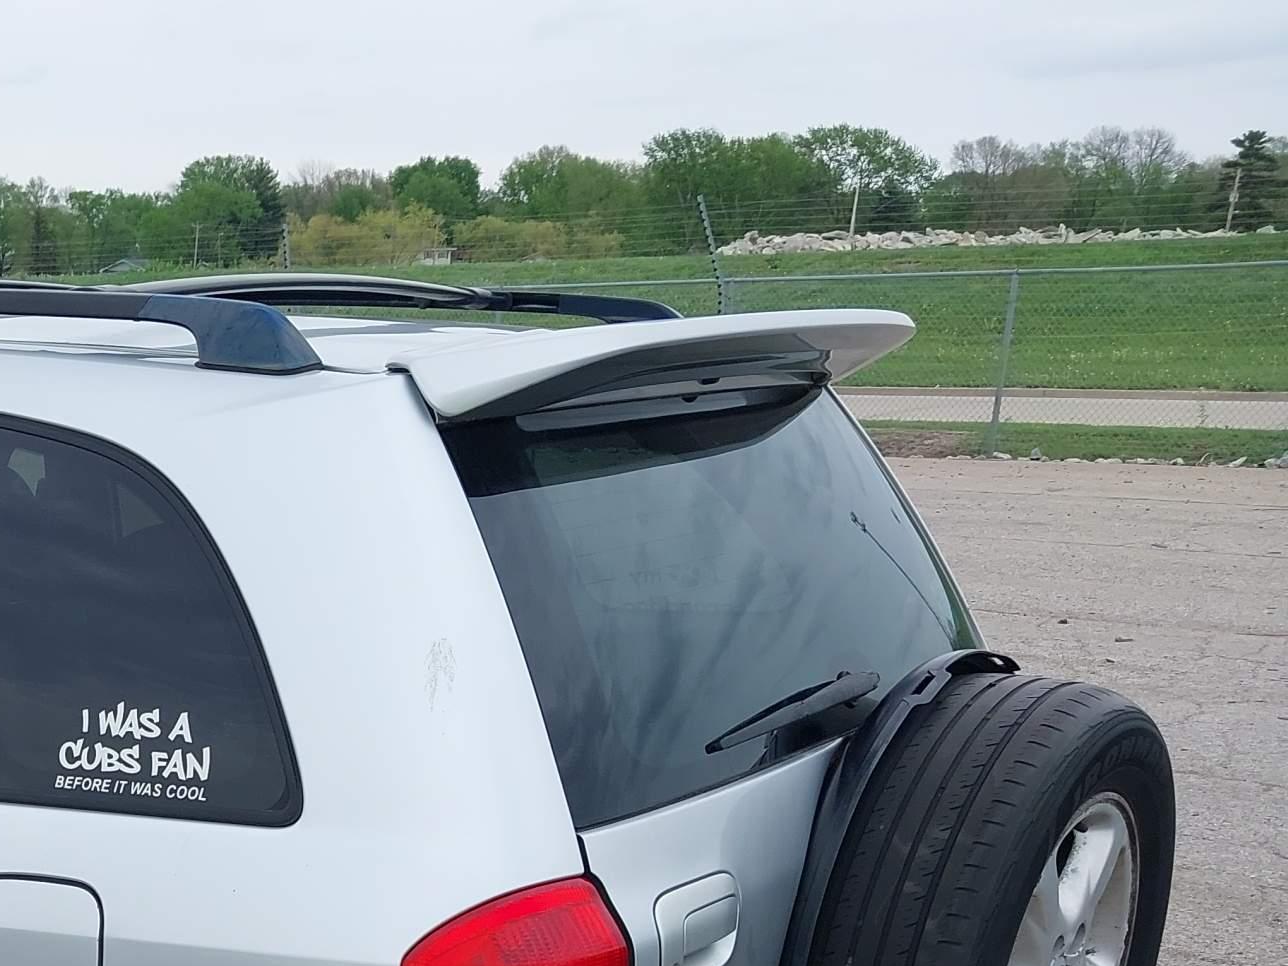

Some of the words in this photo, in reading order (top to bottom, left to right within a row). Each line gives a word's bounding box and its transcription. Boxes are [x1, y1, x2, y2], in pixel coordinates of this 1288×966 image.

[82, 708, 90, 733] I
[98, 701, 162, 741] WAS
[167, 711, 193, 744] A
[58, 737, 142, 775] CUBS
[150, 746, 211, 782] FAN
[54, 775, 112, 793] BEFORE
[113, 780, 129, 794] IT
[130, 781, 163, 797] WAS
[165, 784, 208, 802] COOL
